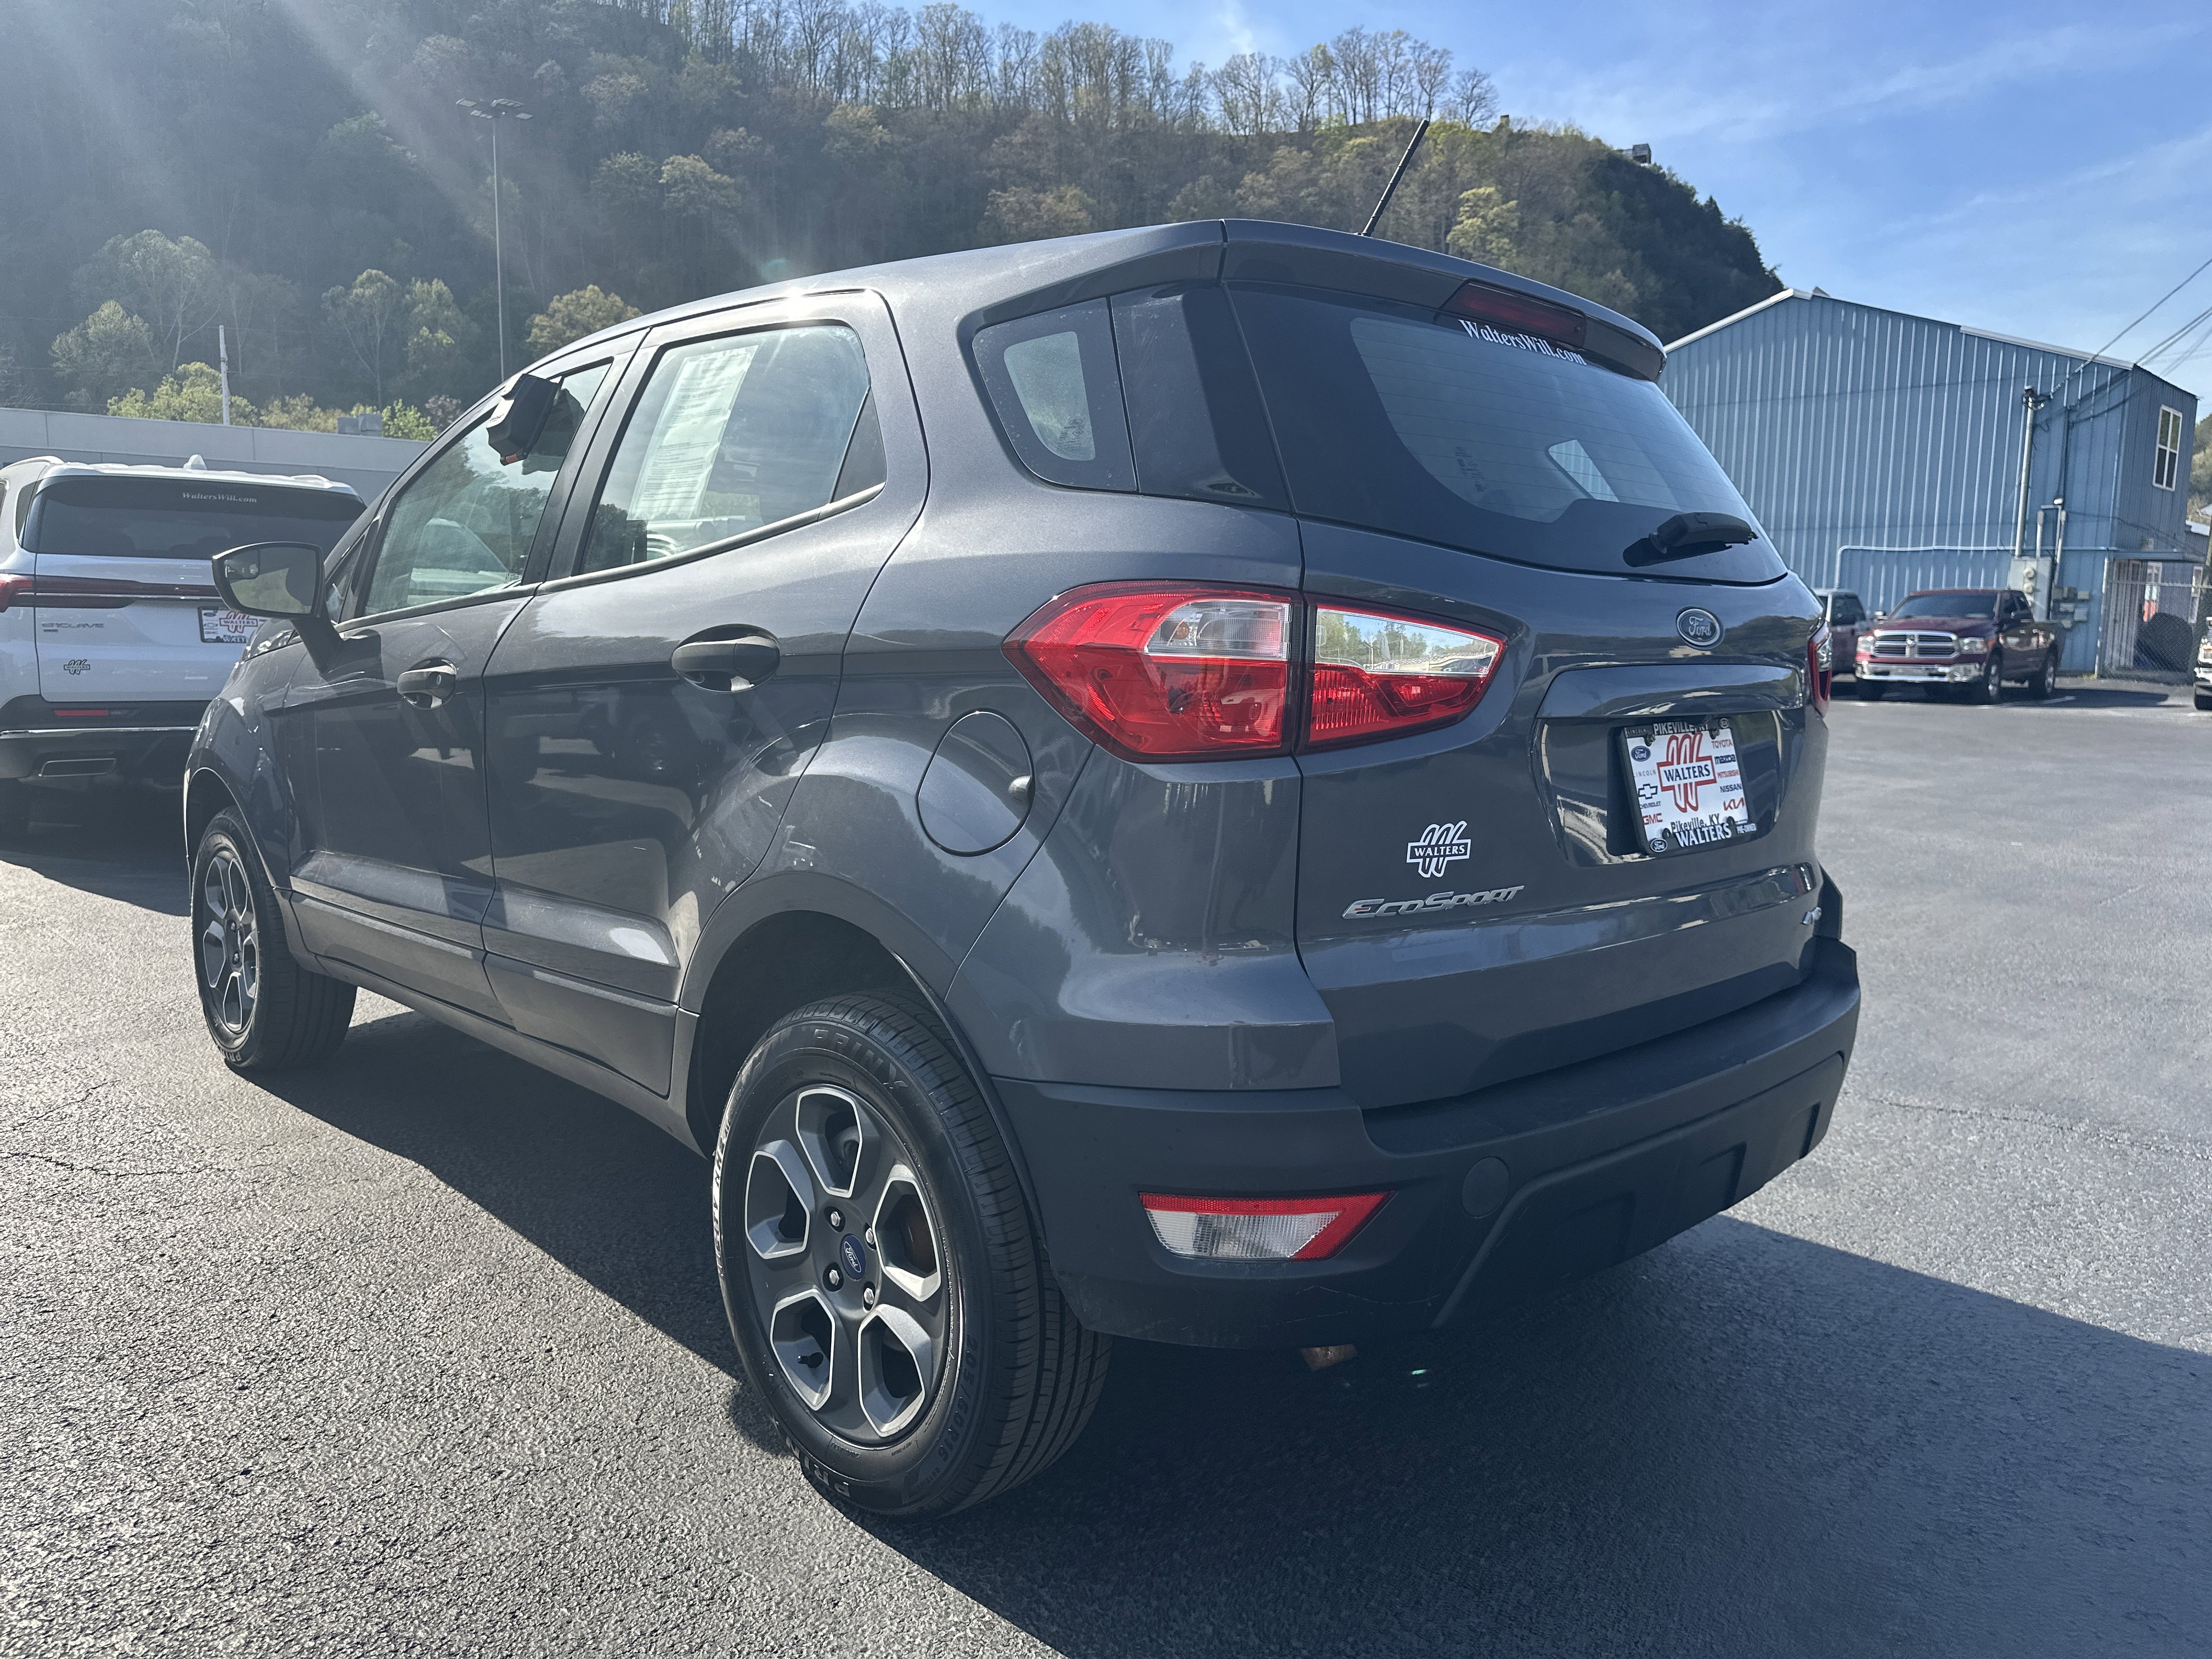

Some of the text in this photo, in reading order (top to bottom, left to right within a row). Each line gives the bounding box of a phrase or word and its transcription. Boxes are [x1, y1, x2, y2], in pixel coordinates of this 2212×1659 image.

[1458, 319, 1587, 365] WaltersWill.com
[183, 493, 257, 503] WaltersWill.com
[1688, 616, 1712, 636] Ford
[1712, 739, 1733, 748] TOYOTA
[1663, 764, 1711, 782] WALTERS
[1720, 783, 1742, 793] NISSAN
[1643, 812, 1663, 825] GMC
[1708, 813, 1719, 826] KY
[1675, 823, 1732, 847] WALTERS
[1414, 845, 1465, 856] WALTERS
